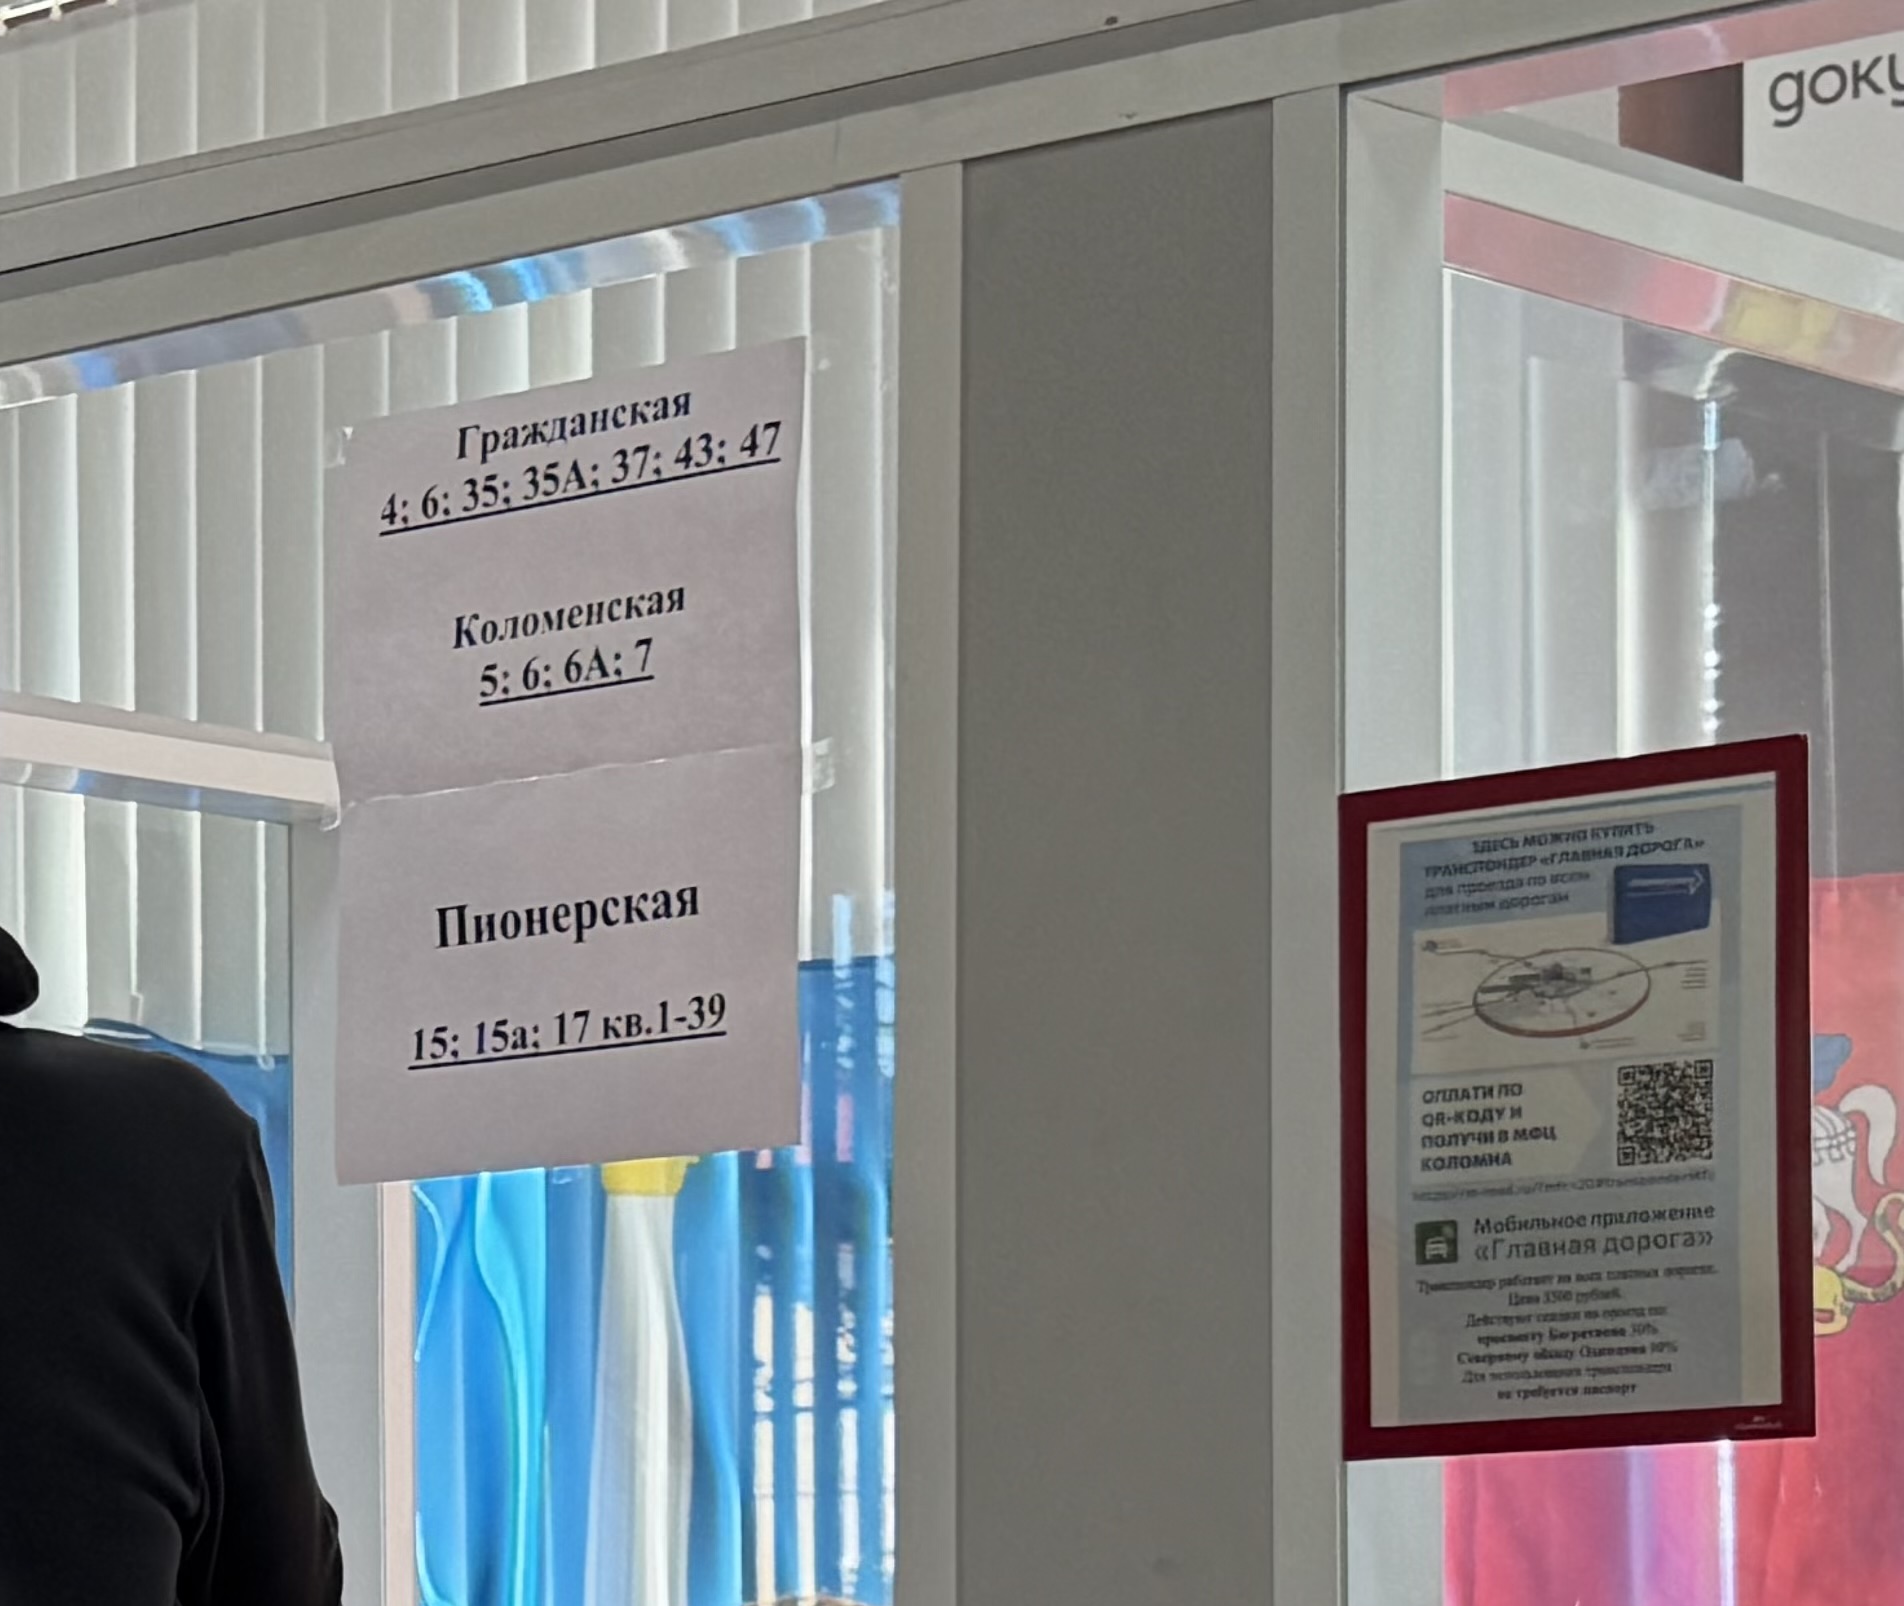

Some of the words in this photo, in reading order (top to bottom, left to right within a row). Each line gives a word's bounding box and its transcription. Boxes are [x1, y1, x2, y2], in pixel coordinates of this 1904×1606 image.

[455, 391, 692, 463] Гражданская
[379, 493, 409, 527] 4;
[421, 485, 451, 519] 6;
[462, 474, 512, 513] 35;
[523, 458, 600, 501] 35А;
[611, 444, 663, 484] 37;
[674, 432, 727, 471] 43;
[740, 420, 782, 459] 47
[452, 586, 686, 650] Коломенская
[479, 664, 510, 699] 5;
[522, 657, 552, 692] 6;
[564, 649, 623, 686] 6А;
[635, 637, 654, 673] 7
[434, 885, 700, 950] Пионерская
[412, 1026, 460, 1061] 15;
[475, 1018, 540, 1056] 15а;
[553, 1009, 591, 1046] 17
[601, 992, 726, 1042] кв.1-39
